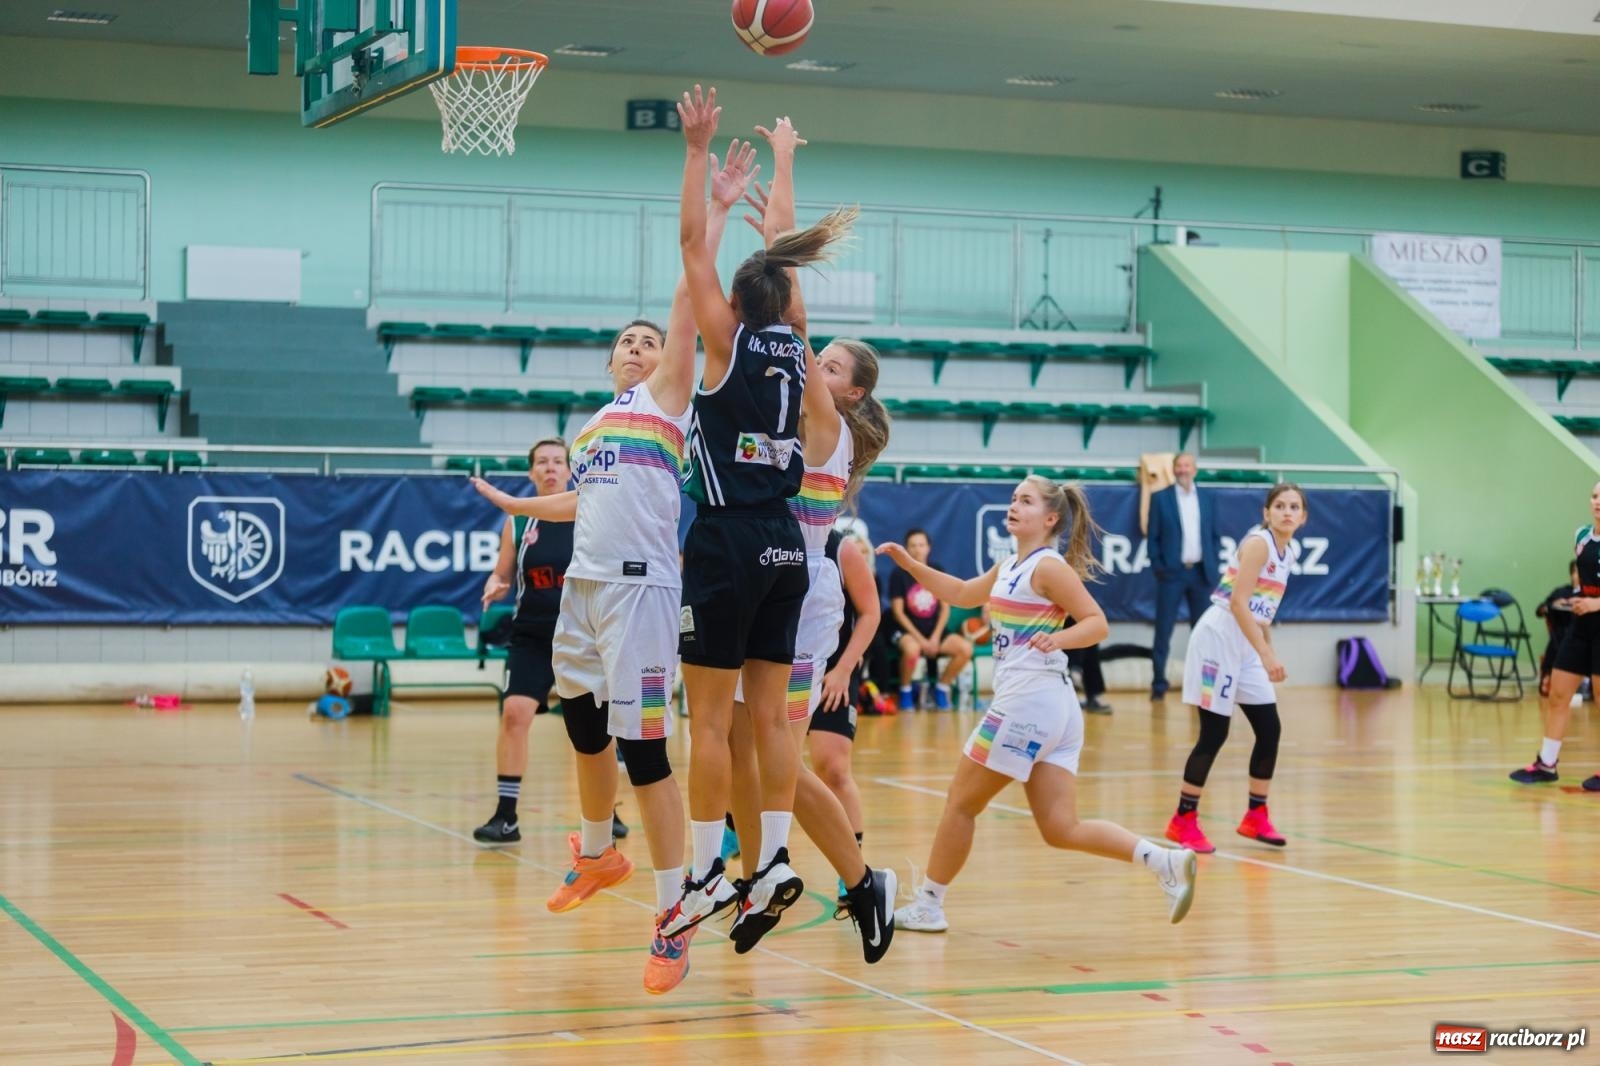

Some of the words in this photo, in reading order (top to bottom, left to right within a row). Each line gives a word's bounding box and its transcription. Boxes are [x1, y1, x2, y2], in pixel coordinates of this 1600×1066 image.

[635, 110, 656, 127] B
[1467, 160, 1491, 176] C
[1389, 241, 1487, 265] MIESZKO
[764, 366, 792, 433] 7
[582, 477, 619, 485] ASKETBALL
[339, 530, 500, 573] RACIB
[772, 548, 804, 562] Clavis
[0, 565, 57, 587] BÓRZ
[1007, 572, 1023, 595] 4
[1220, 675, 1233, 699] 2
